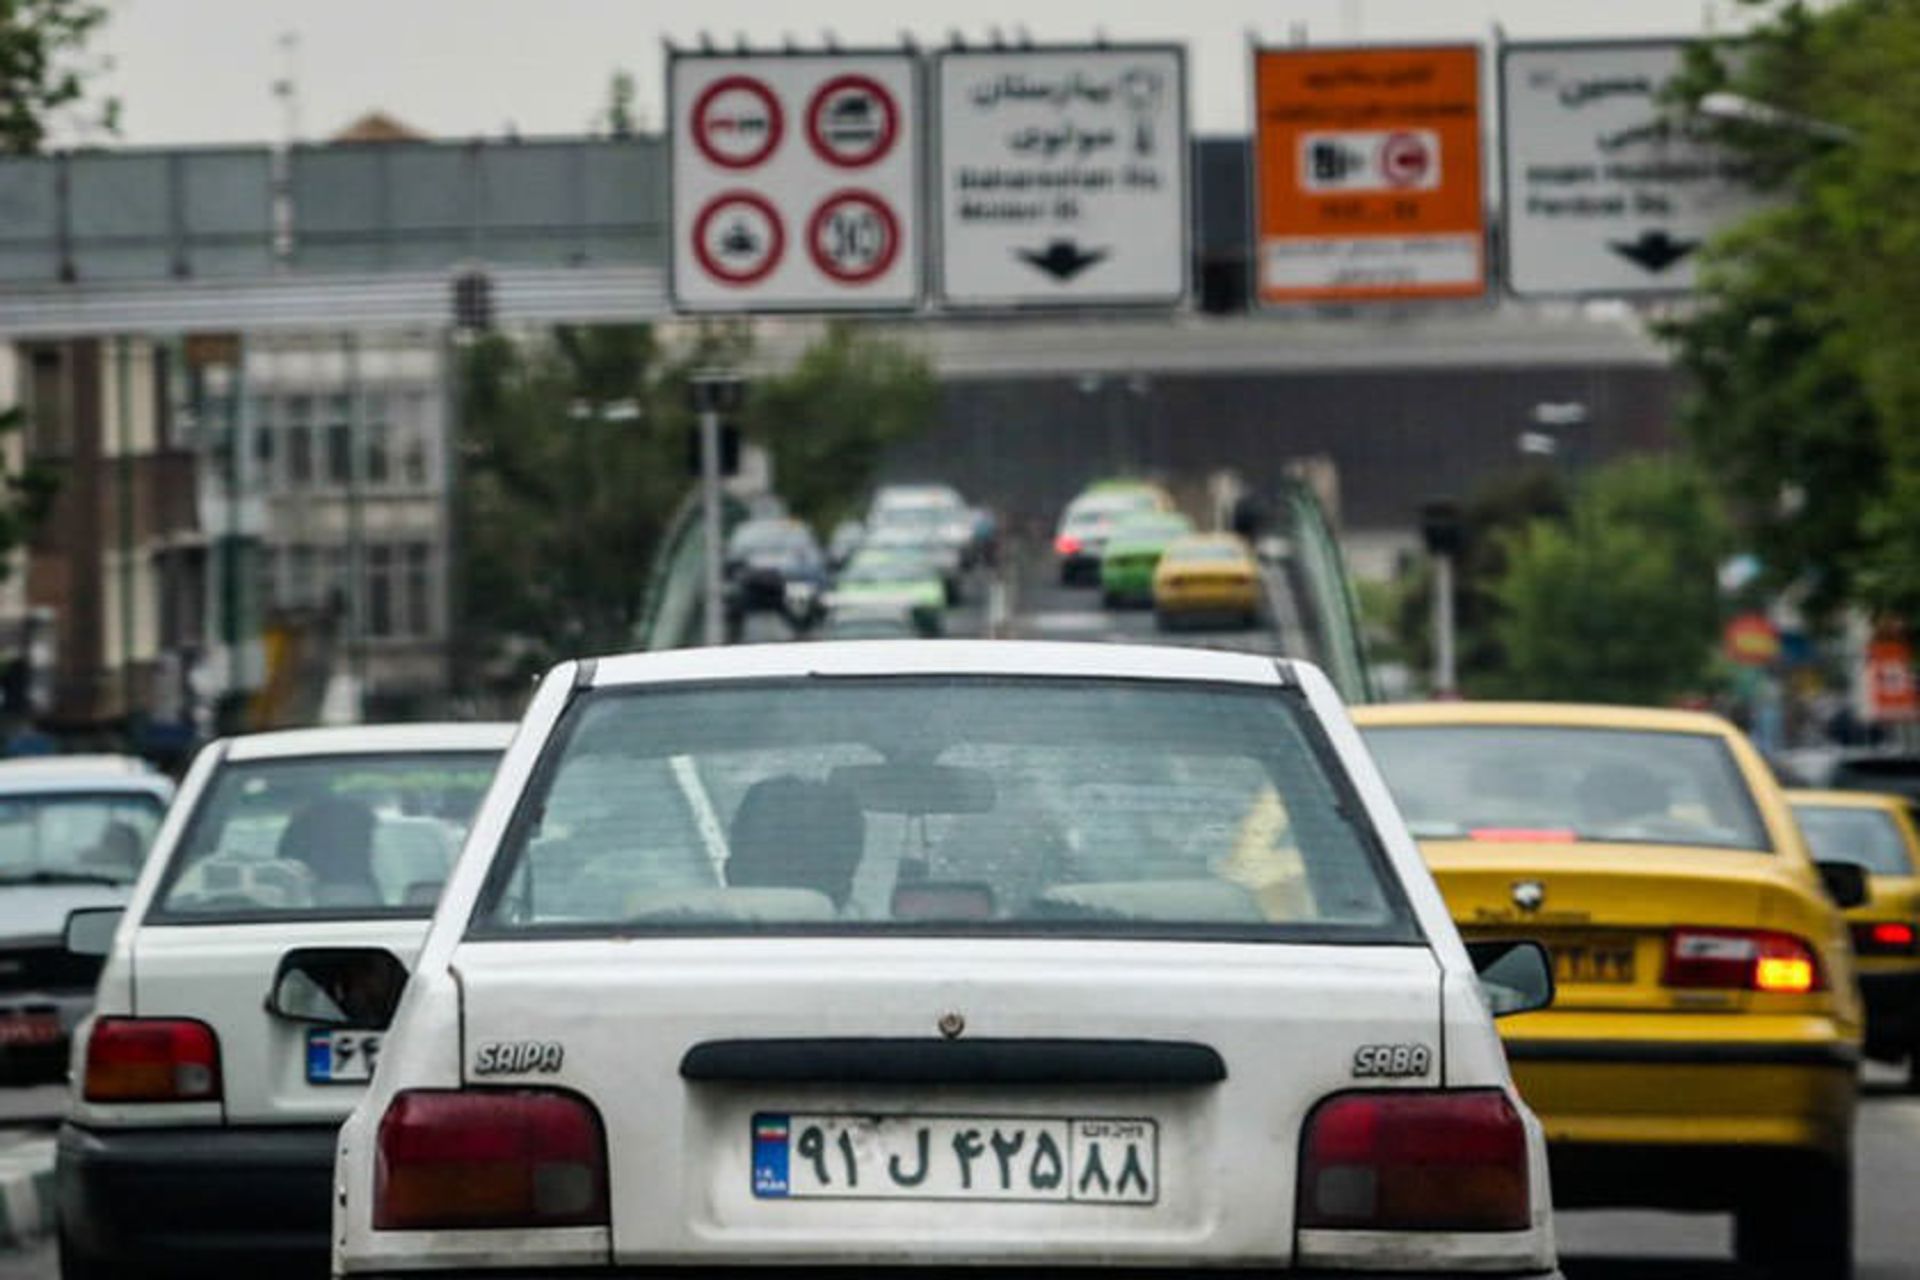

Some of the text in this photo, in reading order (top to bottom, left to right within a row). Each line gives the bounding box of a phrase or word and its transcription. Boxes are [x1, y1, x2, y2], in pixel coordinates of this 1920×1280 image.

[474, 1042, 564, 1075] SAIPA
[1352, 1044, 1431, 1078] SABA
[799, 1125, 1148, 1195] ۹۱ ل ۴۲۵ ۸۸
